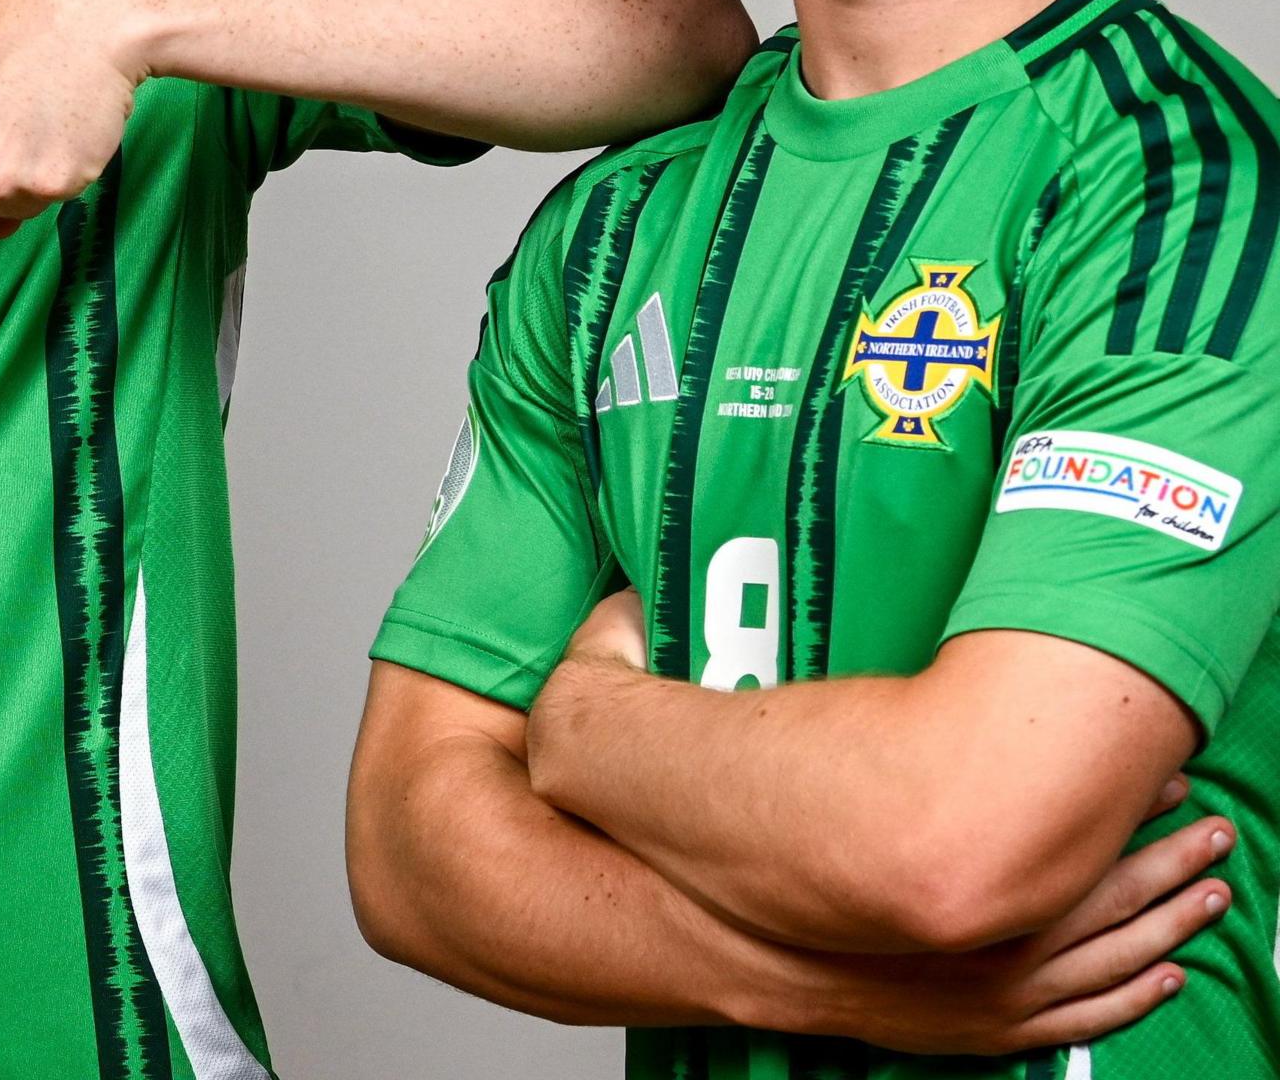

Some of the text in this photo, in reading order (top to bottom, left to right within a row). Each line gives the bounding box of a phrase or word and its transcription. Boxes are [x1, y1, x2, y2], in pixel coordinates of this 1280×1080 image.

[885, 293, 969, 333] IRISH FOOTBALL
[867, 341, 974, 359] NORTHERN IRELAND
[743, 366, 764, 382] U19
[873, 376, 956, 411] ASSOCIATION
[1016, 436, 1054, 456] UEFA
[1134, 503, 1215, 542] for children
